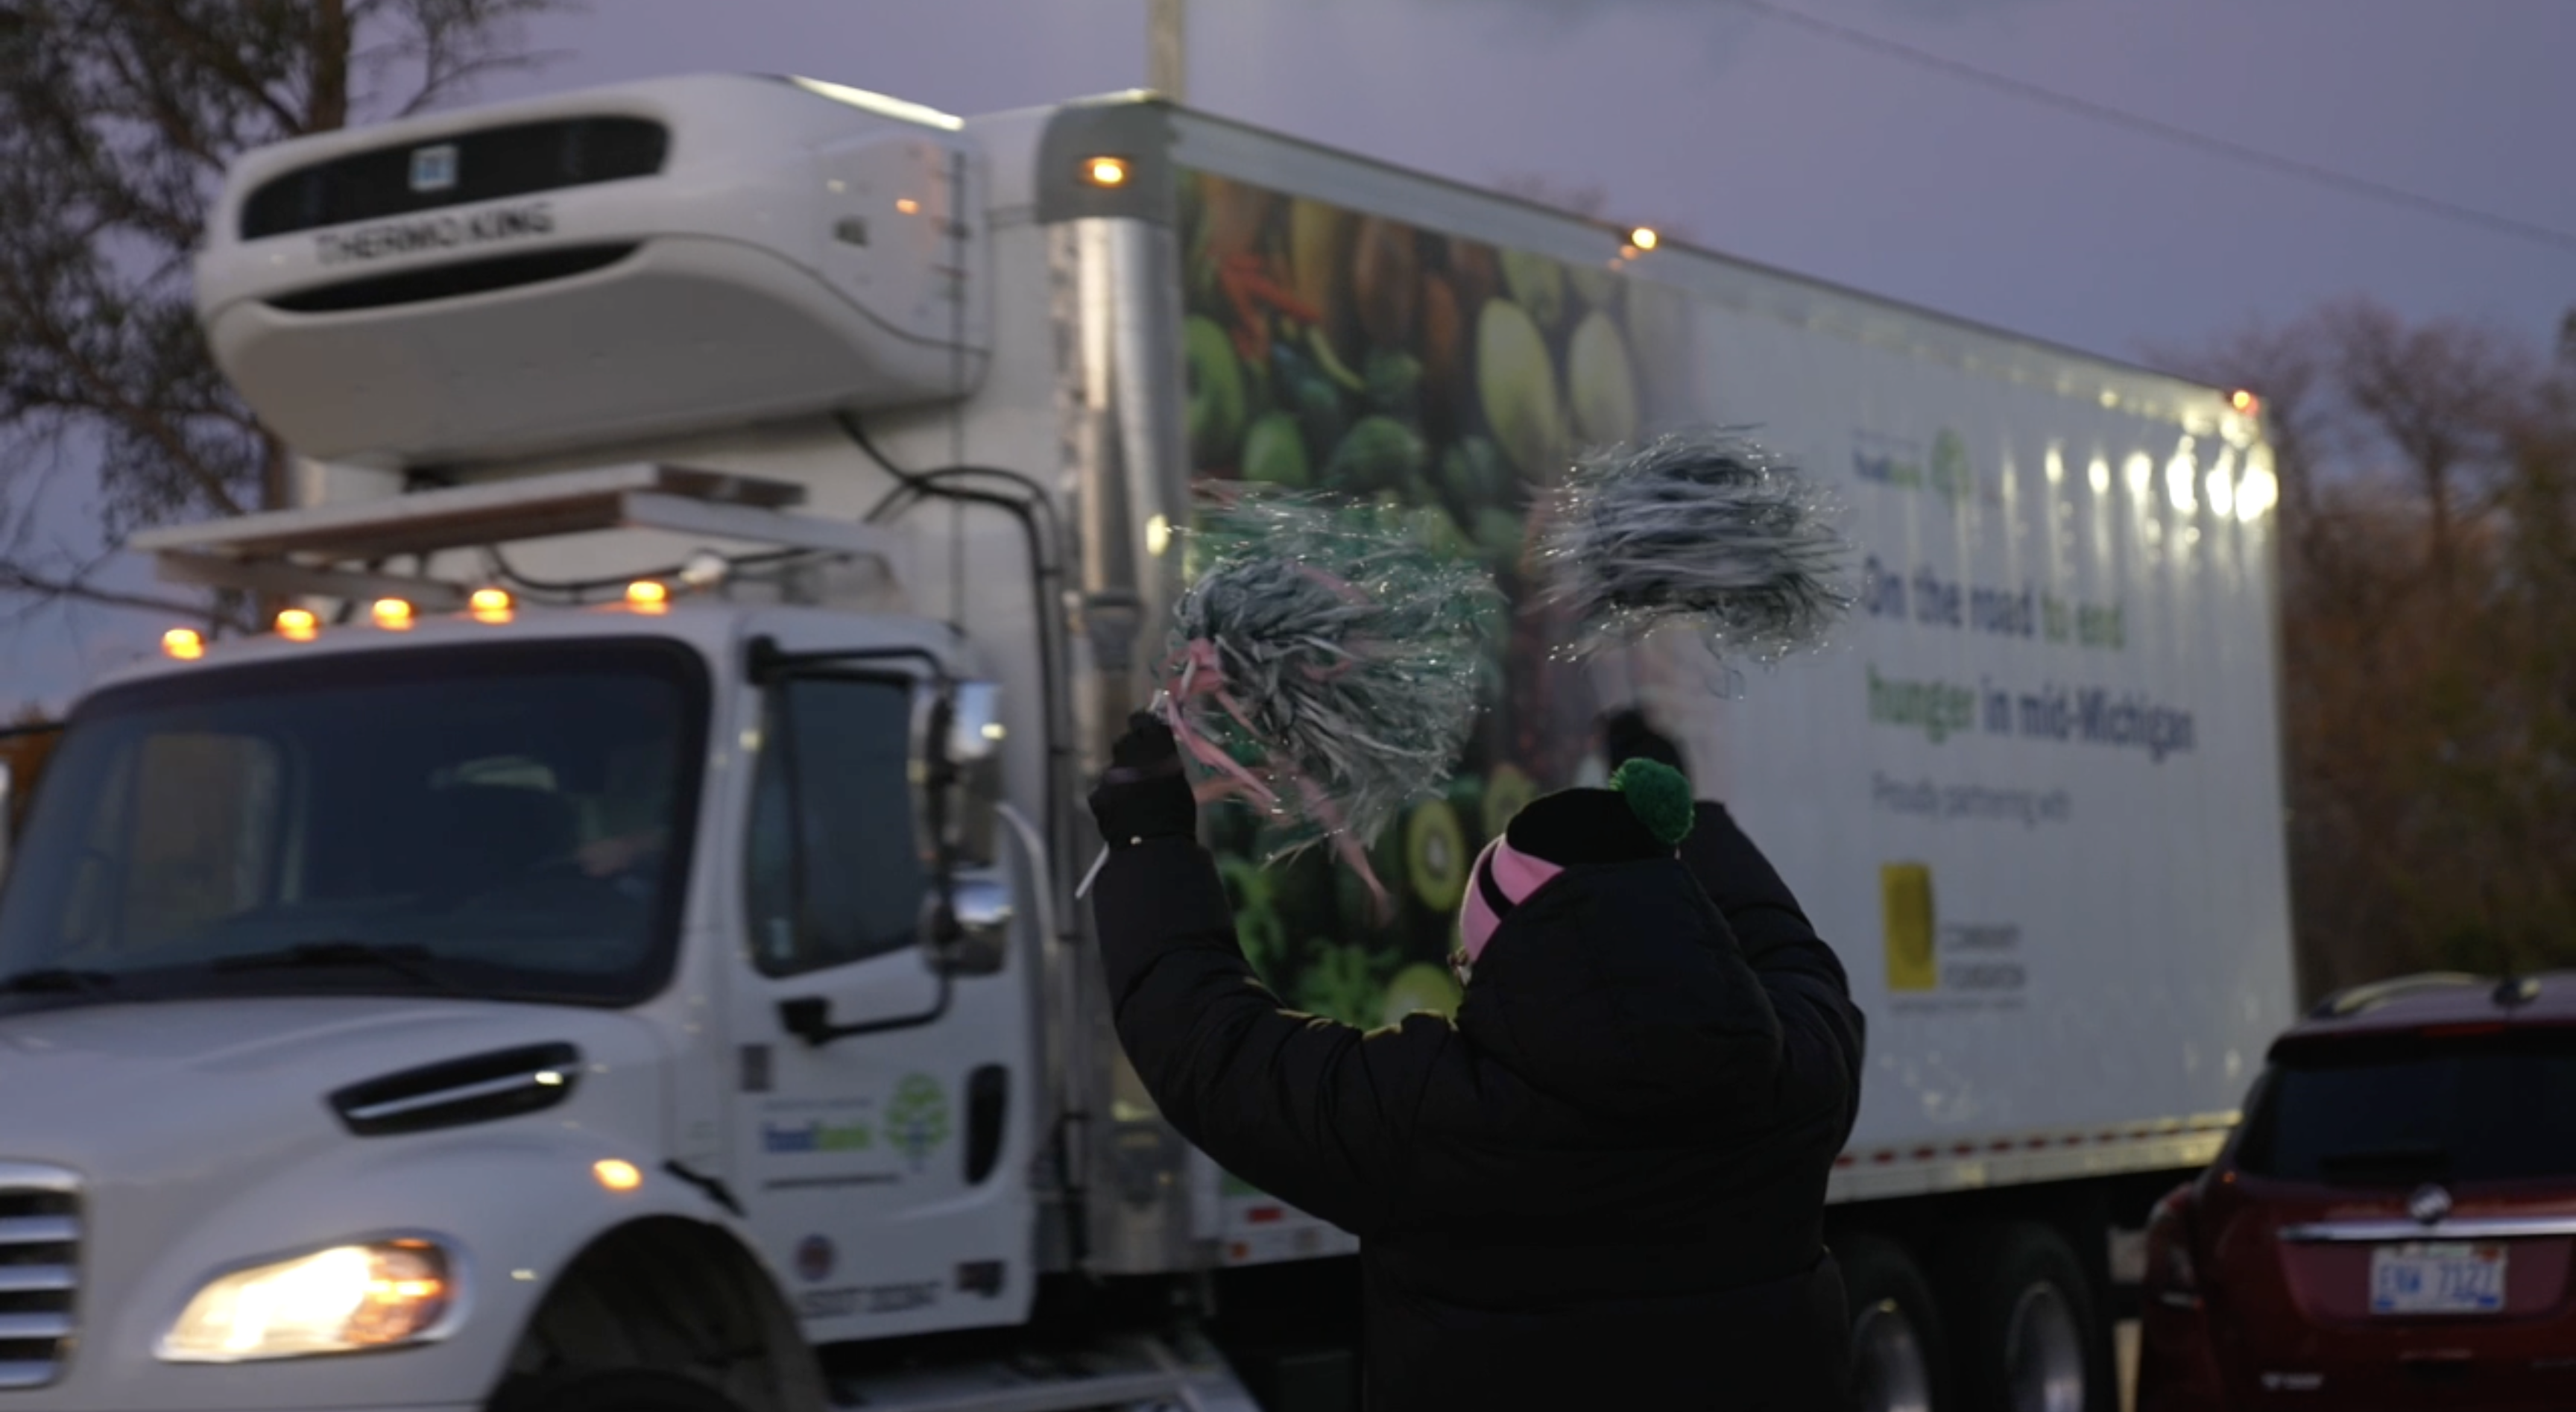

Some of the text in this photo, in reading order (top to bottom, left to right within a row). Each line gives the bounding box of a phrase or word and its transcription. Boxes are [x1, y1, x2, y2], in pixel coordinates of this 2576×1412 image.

[314, 201, 555, 264] THERMO KING
[1862, 553, 2126, 651] On the road to end
[1864, 659, 2197, 765] hunger in mid-Michigan
